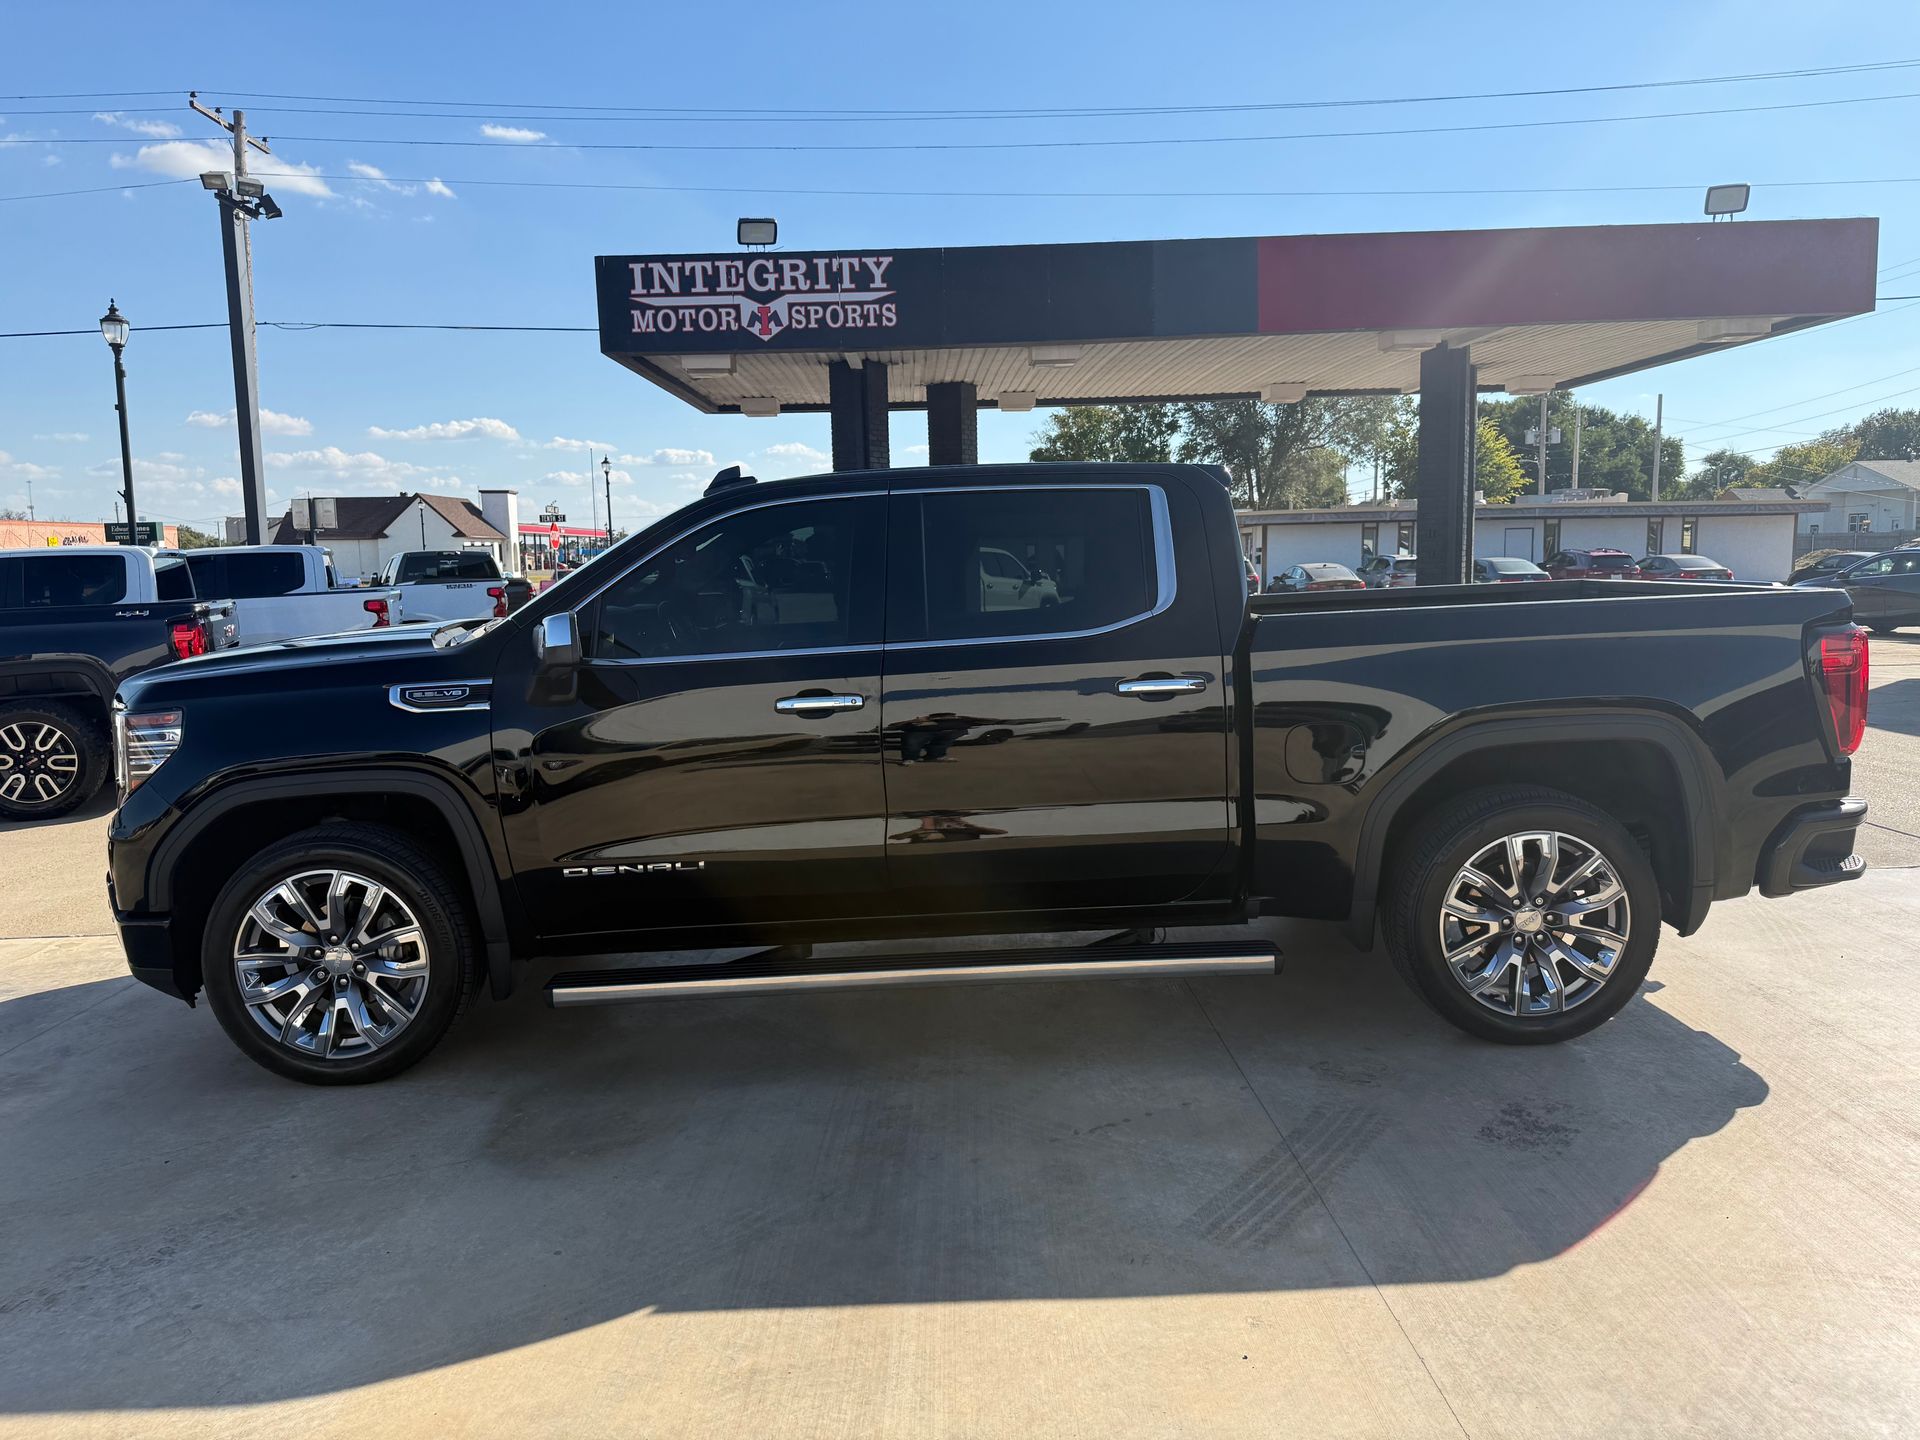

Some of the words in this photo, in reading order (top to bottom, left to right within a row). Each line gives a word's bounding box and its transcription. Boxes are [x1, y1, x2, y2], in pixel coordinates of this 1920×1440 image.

[629, 256, 893, 295] INTEGRITY
[631, 308, 738, 333] MOTOR
[791, 303, 897, 329] SPORTS
[563, 860, 705, 878] DENALI
